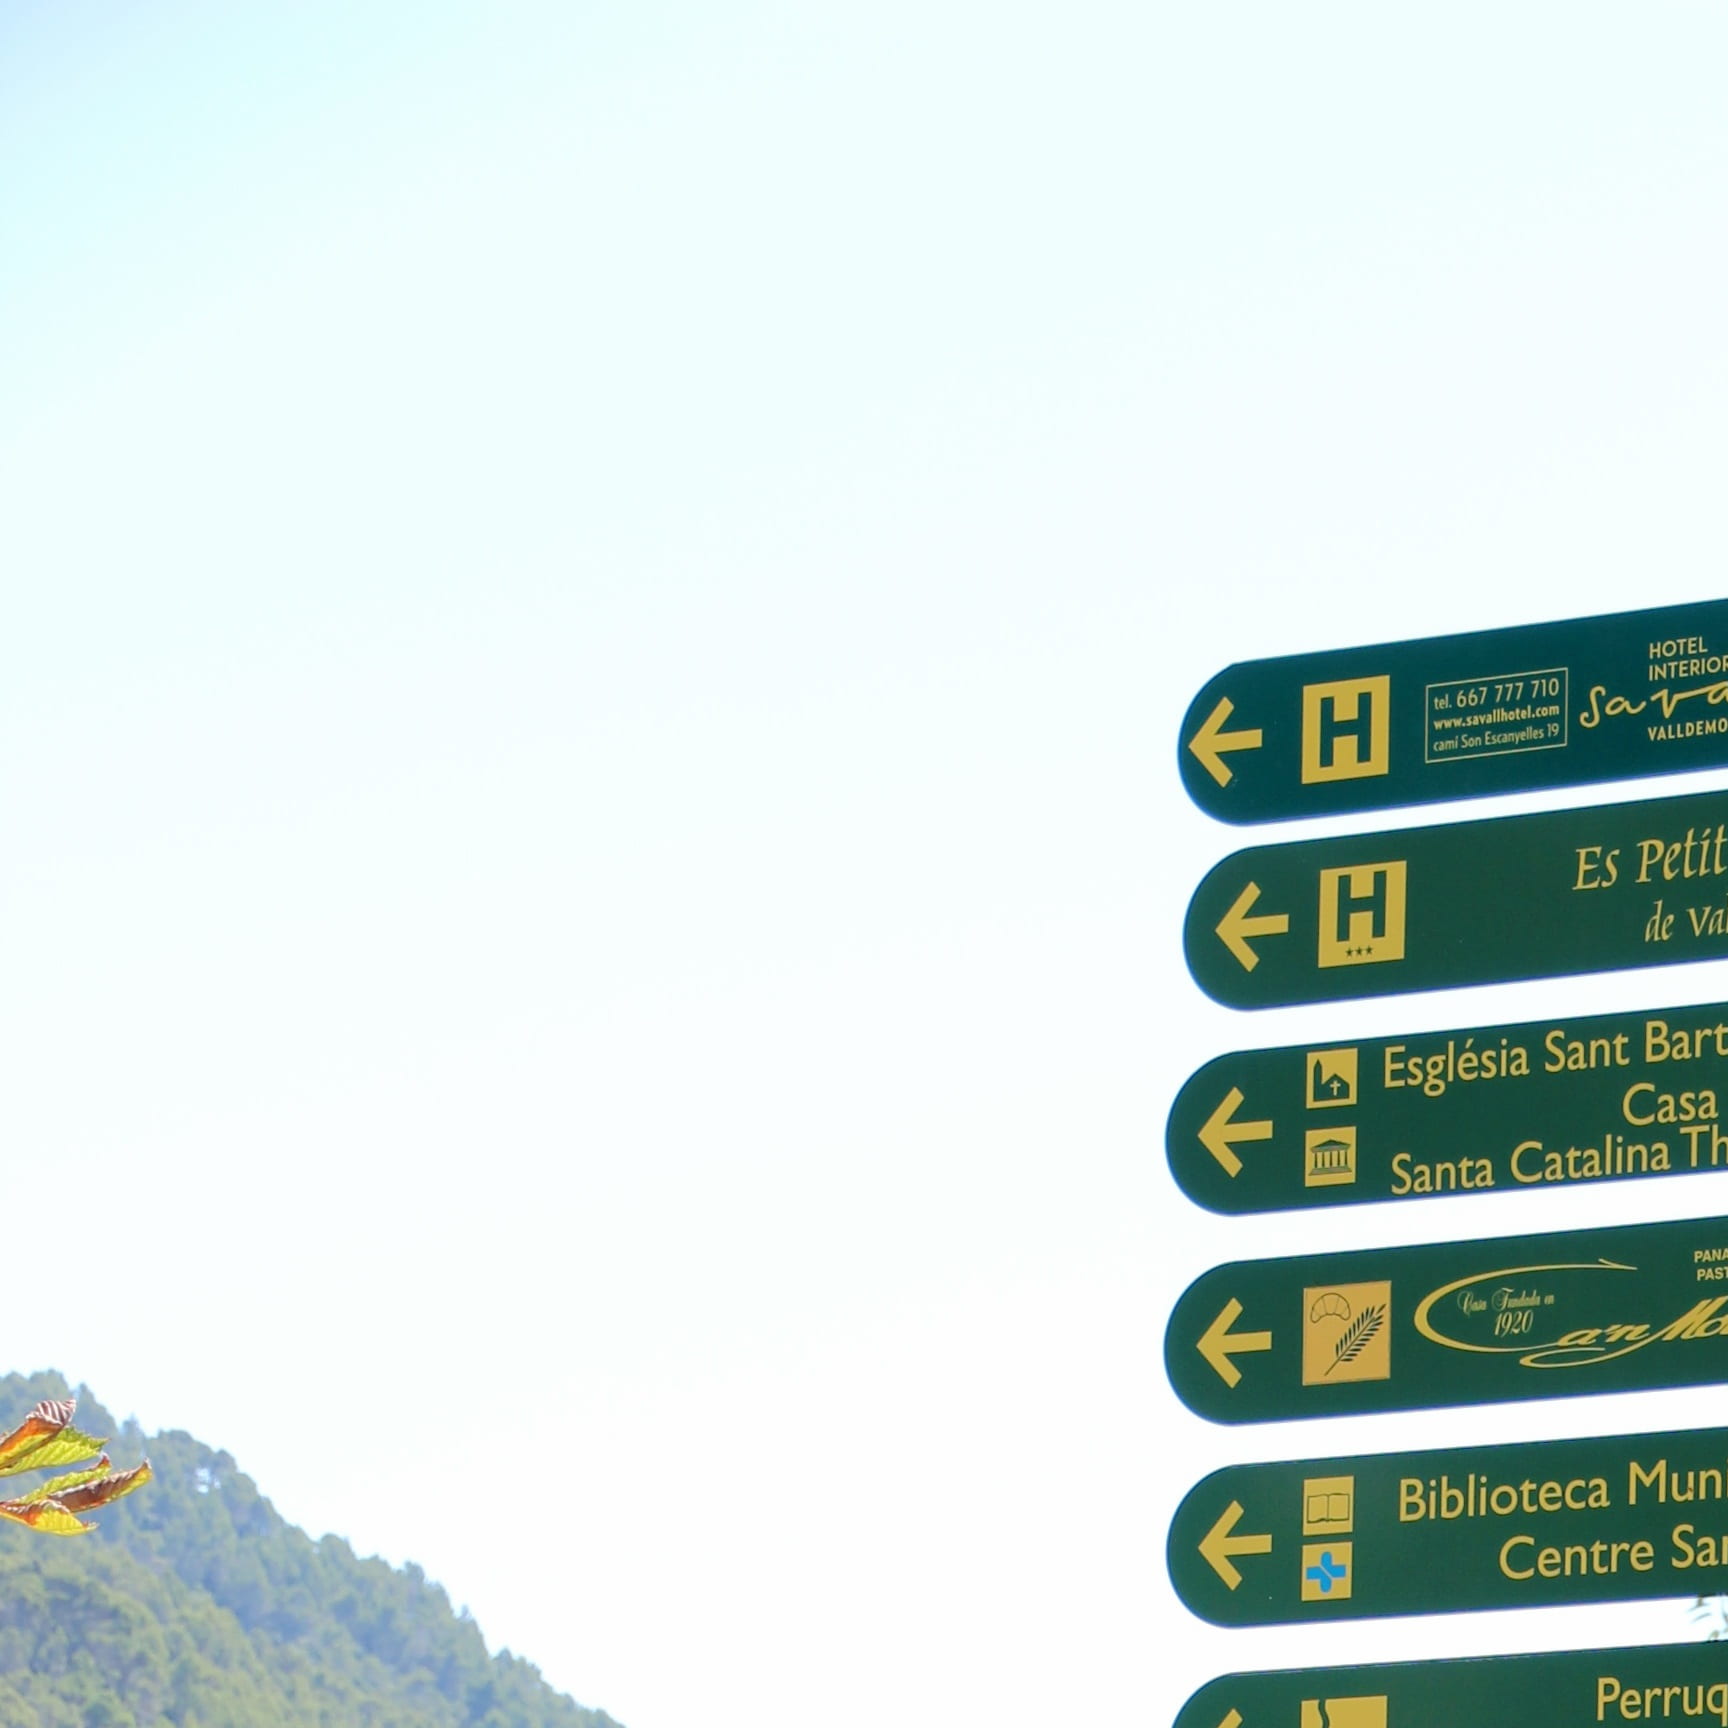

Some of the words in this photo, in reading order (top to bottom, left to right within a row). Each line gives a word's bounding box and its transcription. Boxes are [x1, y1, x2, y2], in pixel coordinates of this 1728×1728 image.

[1649, 637, 1708, 658] HOTEL
[1434, 694, 1452, 710] tel.
[1457, 687, 1487, 707] 667
[1495, 682, 1523, 702] 777
[1531, 678, 1559, 698] 710
[1434, 705, 1559, 730] www.savallhotel.com
[1461, 735, 1481, 748] Son
[1485, 727, 1543, 744] Escanyelles
[1548, 723, 1559, 736] 19
[1574, 847, 1619, 889] Es
[1637, 825, 1725, 882] Petit
[1645, 900, 1674, 941] de
[1385, 1039, 1529, 1096] Església
[1545, 1030, 1629, 1072] Sant
[1623, 1083, 1718, 1125] Casa
[1392, 1153, 1493, 1194] Santa
[1511, 1134, 1670, 1182] Catalina
[1495, 1310, 1533, 1337] 1920
[1400, 1474, 1610, 1521] Biblioteca
[1500, 1536, 1654, 1579] Centre
